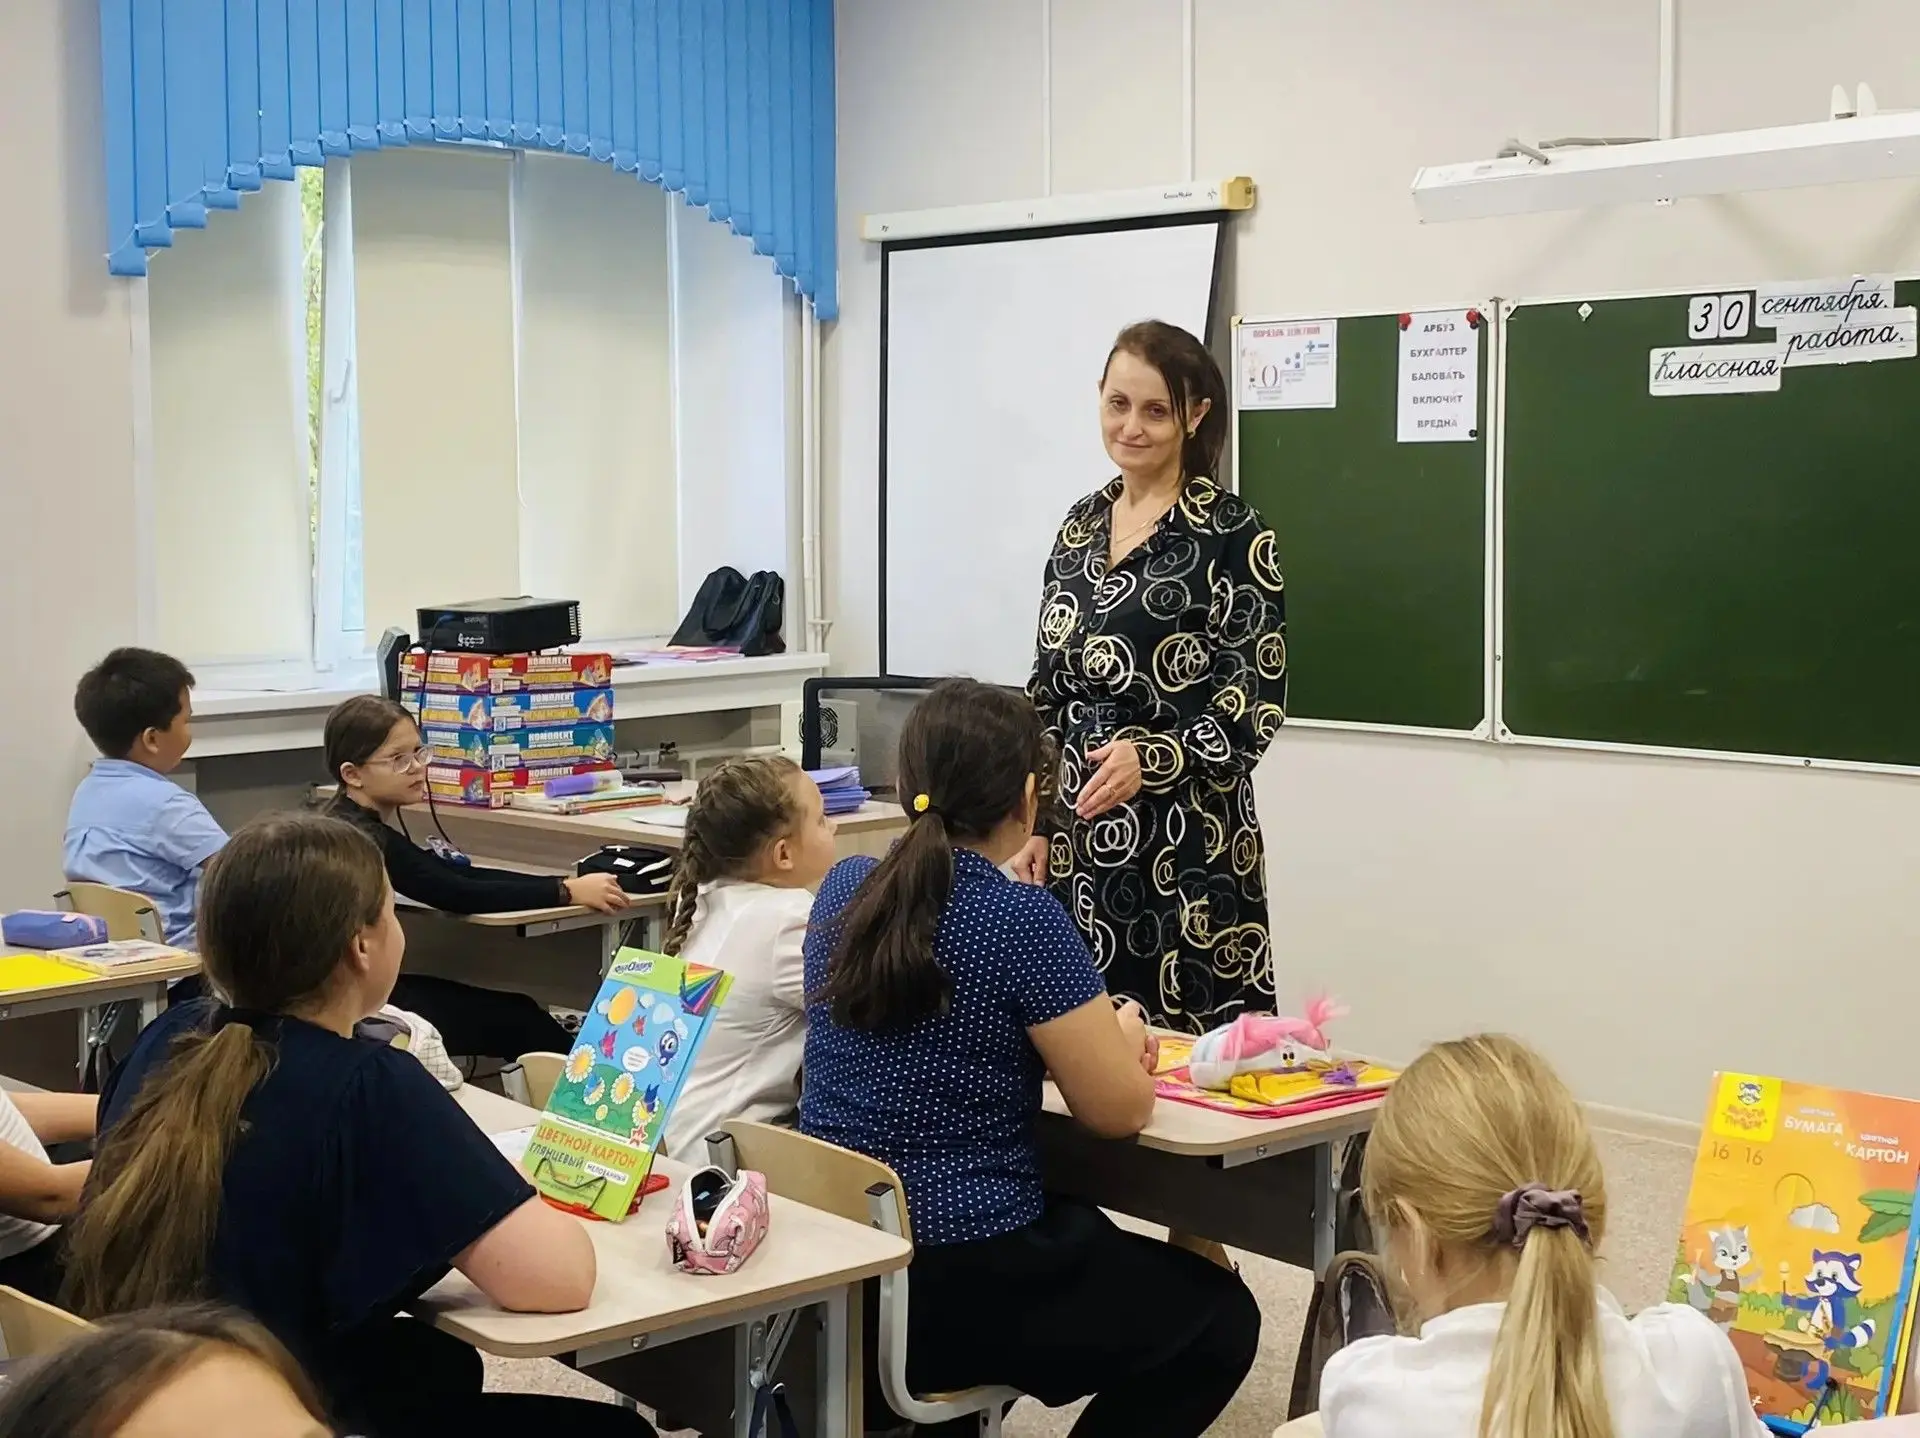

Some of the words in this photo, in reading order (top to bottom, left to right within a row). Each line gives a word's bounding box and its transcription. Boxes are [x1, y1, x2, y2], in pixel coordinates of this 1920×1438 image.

[1693, 300, 1744, 332] 30
[1423, 323, 1455, 333] АРБУЗ
[1410, 347, 1467, 358] БУХГАЛТЕР
[1411, 371, 1465, 381] БАЛОВАТЬ
[1412, 395, 1463, 404] ВКЛЮЧИТ
[1417, 419, 1457, 428] ВРЕДНА
[1784, 1115, 1844, 1136] БУМАГА
[528, 1142, 585, 1169] ГЛЯНЦЕВЫЙ
[535, 1126, 592, 1153] ЦВЕТНОЙ
[591, 1144, 638, 1169] КАРТОН
[1711, 1141, 1730, 1160] 16
[1744, 1147, 1764, 1166] 16
[1845, 1143, 1910, 1165] КАРТОН
